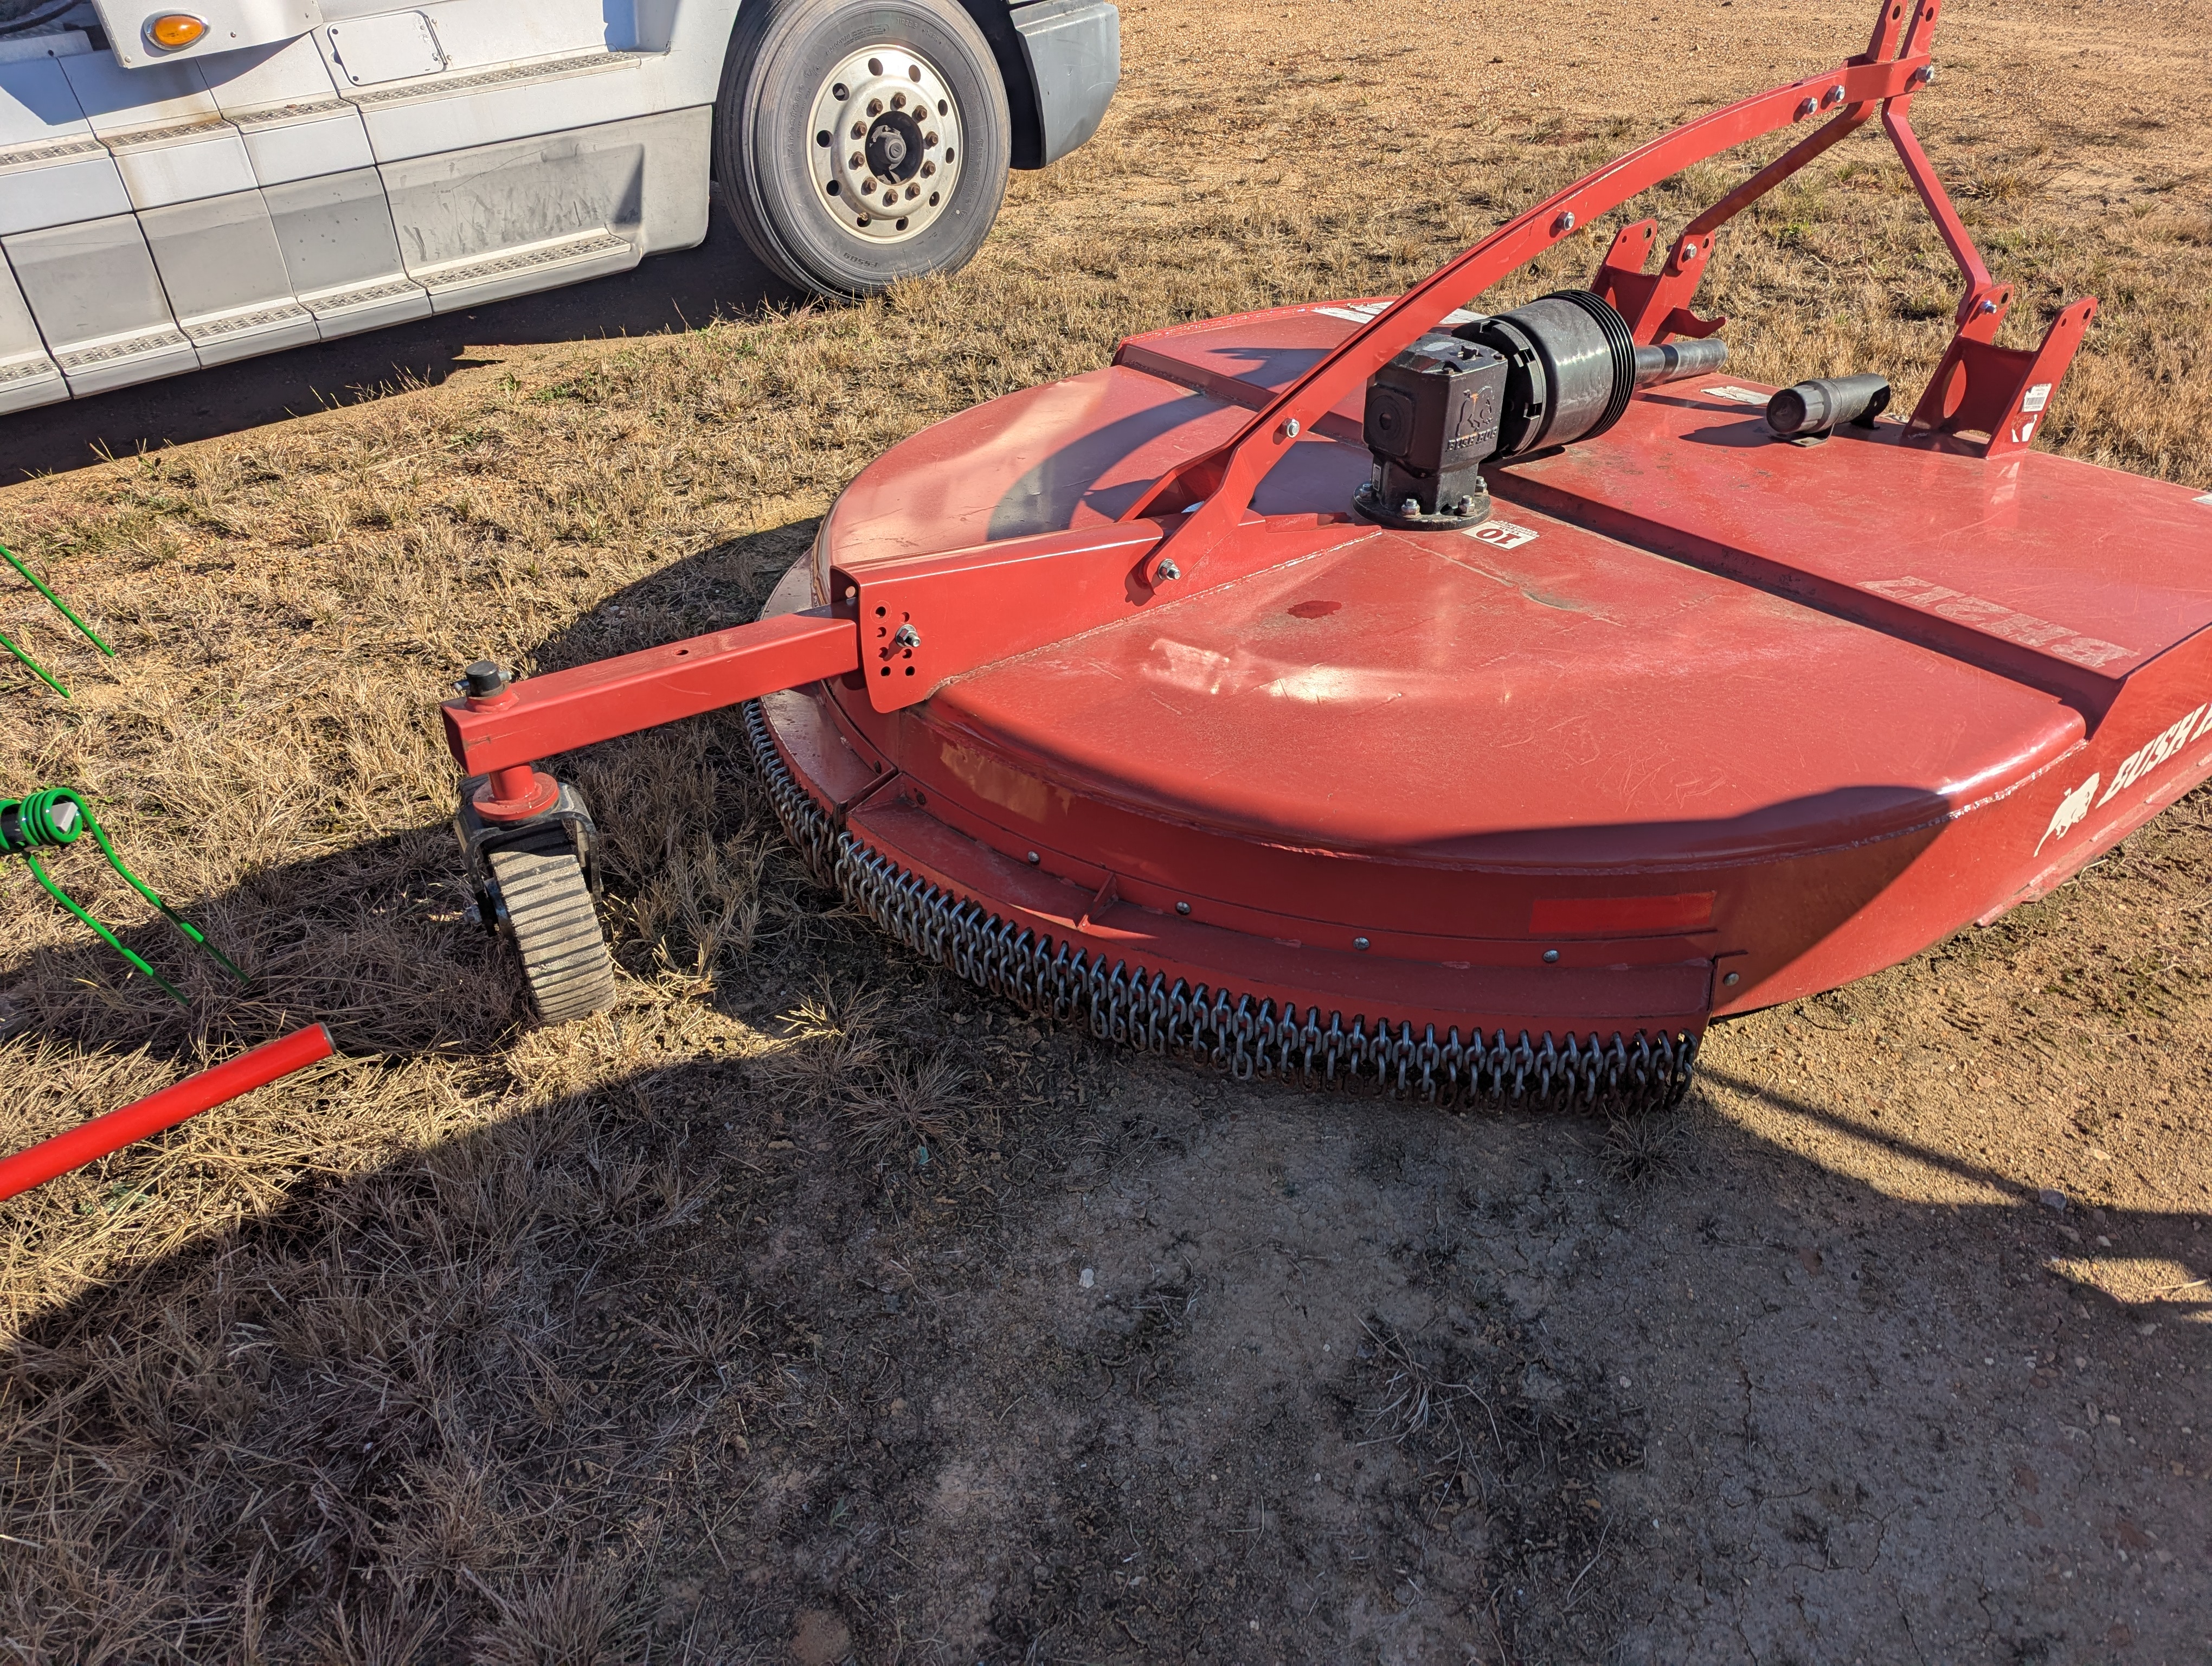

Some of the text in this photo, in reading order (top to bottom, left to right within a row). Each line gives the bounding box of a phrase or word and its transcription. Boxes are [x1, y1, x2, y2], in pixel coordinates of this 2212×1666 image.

[788, 84, 806, 157] Firestone
[966, 138, 984, 204] Firestone
[1476, 528, 1522, 544] 10
[1499, 527, 1519, 535] YEAR
[1856, 576, 2140, 668] BH217
[2095, 702, 2208, 810] BUSH
